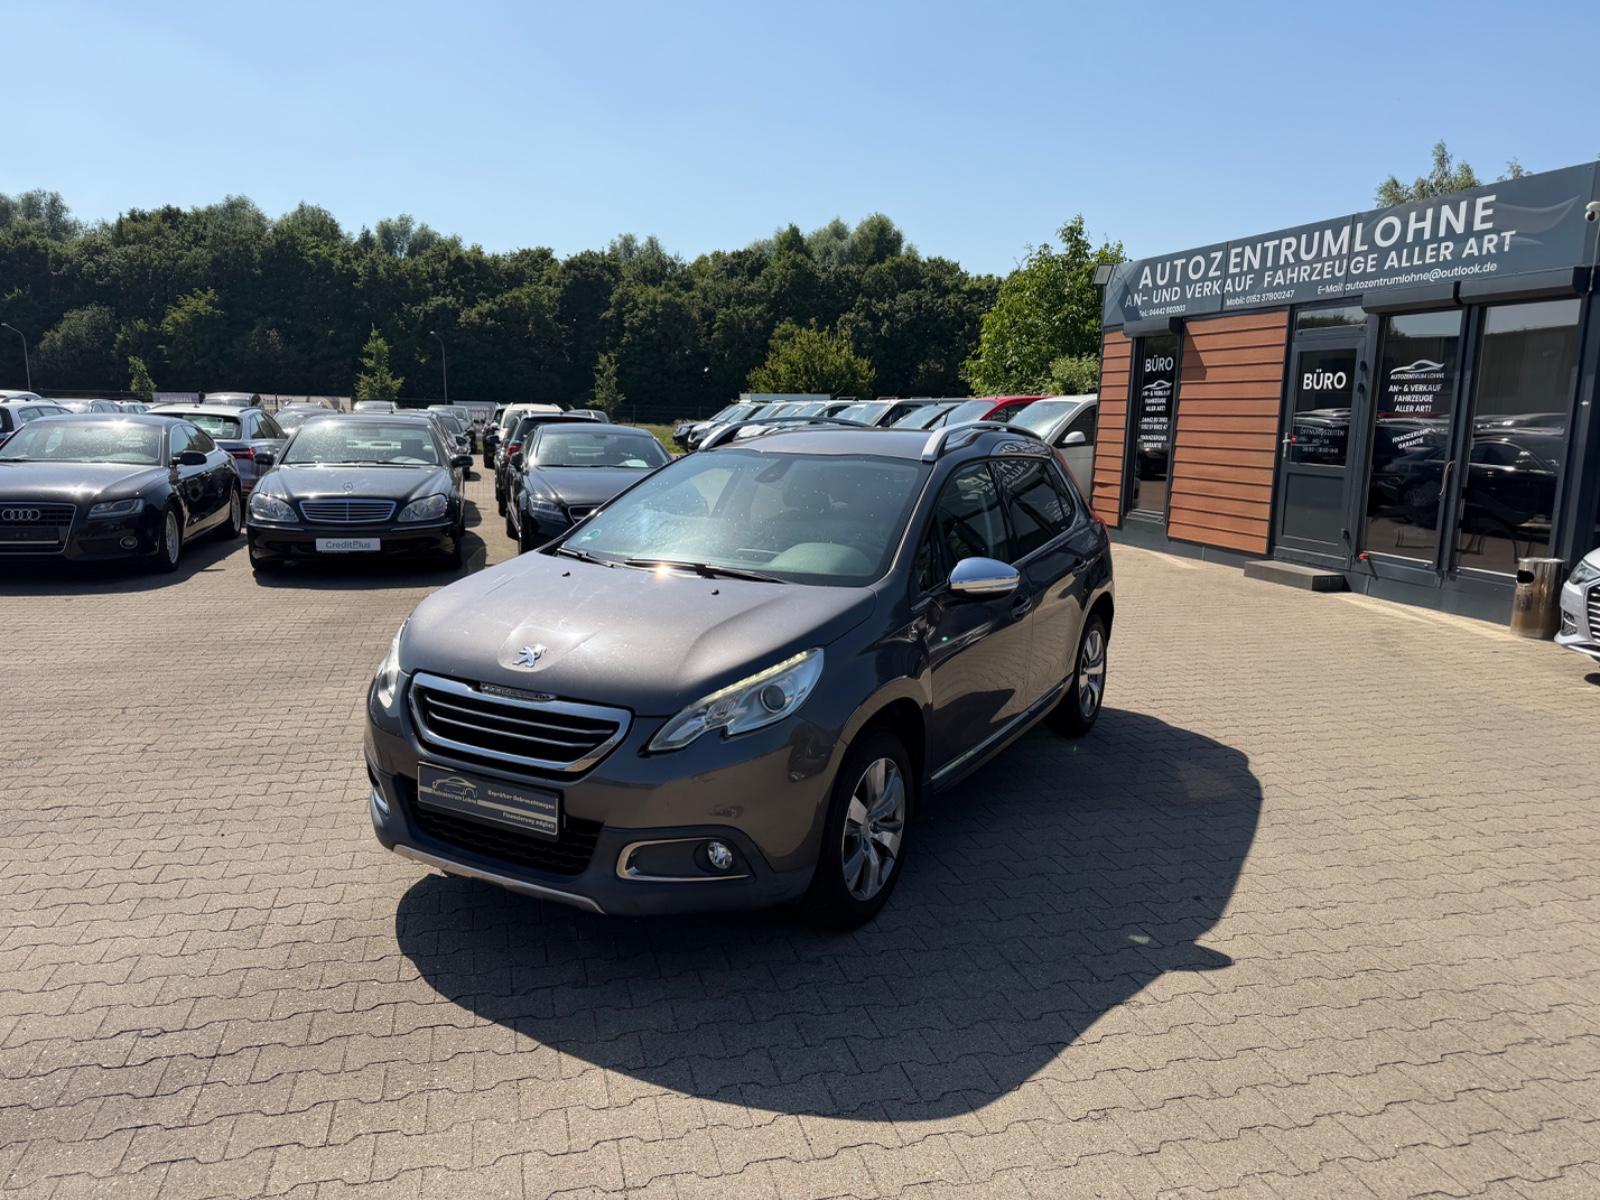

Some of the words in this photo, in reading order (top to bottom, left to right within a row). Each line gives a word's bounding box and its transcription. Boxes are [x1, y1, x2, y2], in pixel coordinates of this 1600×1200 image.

[1124, 293, 1148, 308] AN-
[1152, 287, 1181, 303] UND
[1186, 274, 1255, 299] VERKAUF
[1264, 253, 1378, 288] FAHRZEUGE
[1384, 241, 1454, 270] ALLER
[1461, 230, 1517, 258] ART
[1345, 261, 1498, 291] autozentrumlohne@outlook.de
[1144, 354, 1174, 372] BÜRO
[1303, 368, 1347, 390] BÜRO
[1410, 384, 1442, 392] VERKAUF
[1394, 394, 1434, 403] FAHRZEUGE
[1395, 404, 1414, 412] ALLER
[325, 540, 371, 549] CreditPlus
